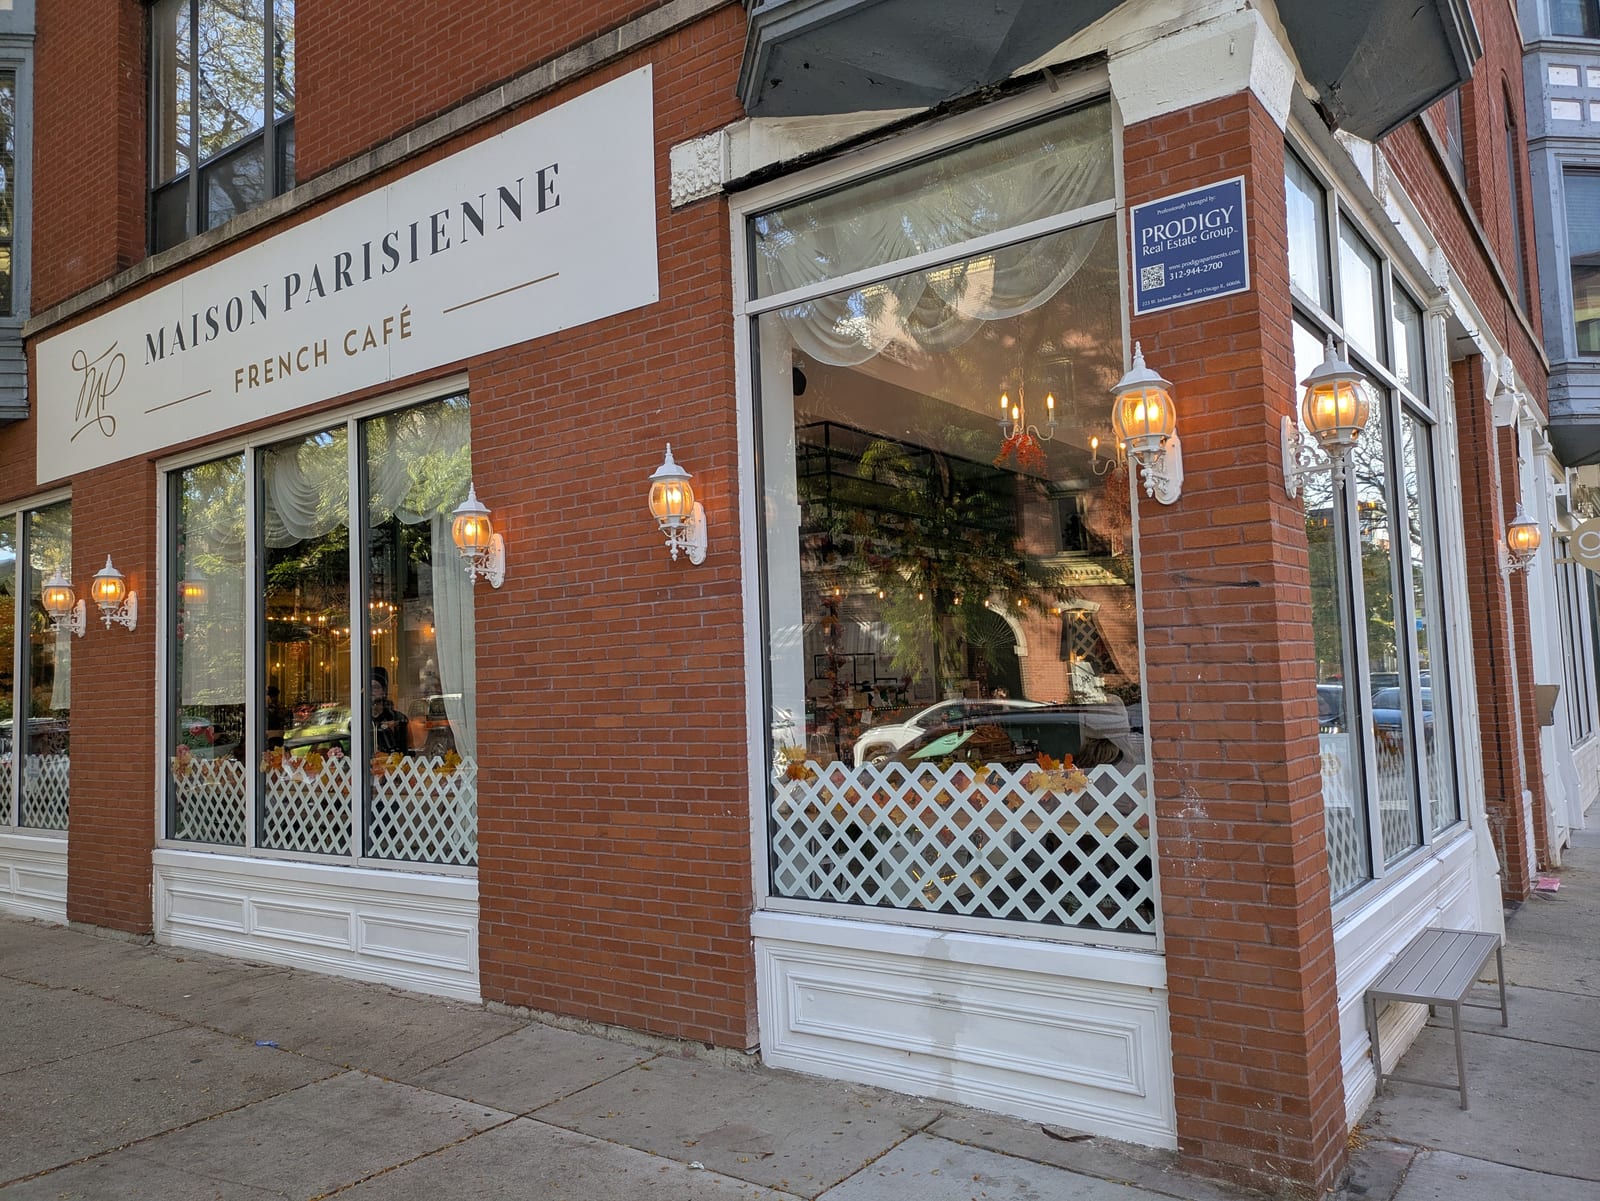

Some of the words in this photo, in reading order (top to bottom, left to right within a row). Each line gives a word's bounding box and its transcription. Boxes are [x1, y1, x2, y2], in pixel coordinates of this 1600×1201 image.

[1142, 205, 1234, 245] PRODIGY
[1142, 241, 1164, 256] Real
[1167, 235, 1198, 250] Estate
[1200, 226, 1234, 241] Group
[144, 283, 269, 366] MAISON
[283, 163, 561, 313] PARISIENNE
[1169, 261, 1223, 280] 312-944-2700
[234, 339, 328, 393] FRENCH
[343, 304, 412, 357] CAFÉ
